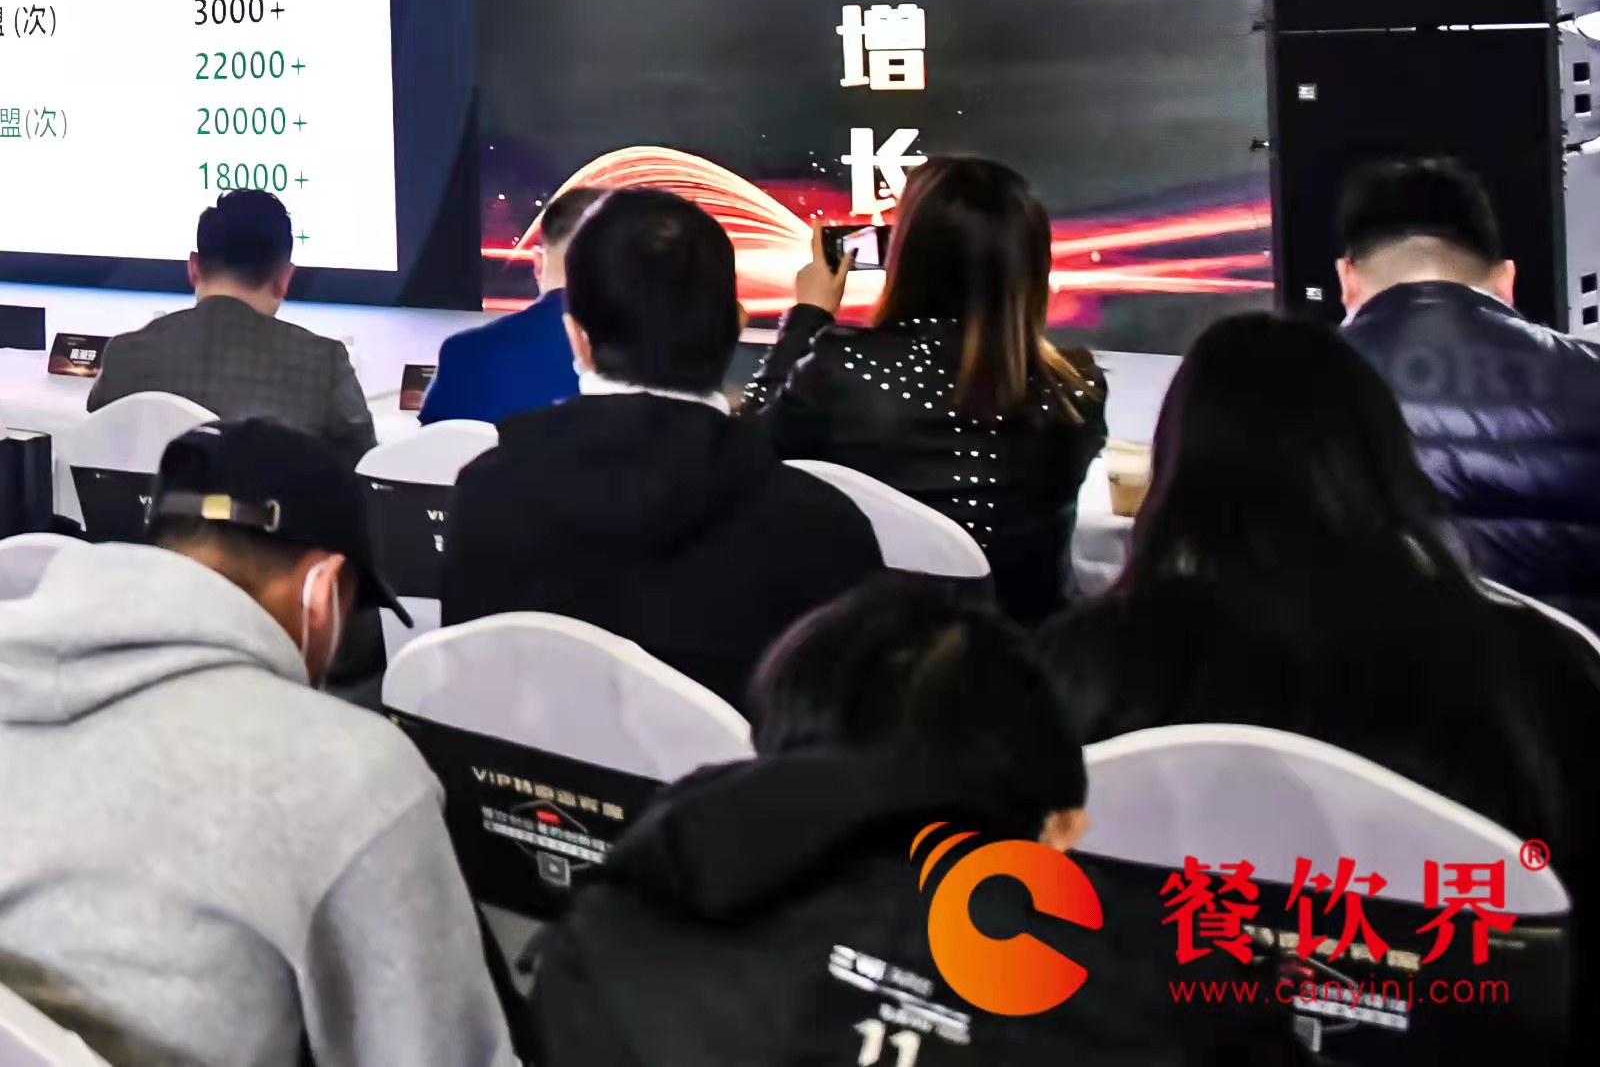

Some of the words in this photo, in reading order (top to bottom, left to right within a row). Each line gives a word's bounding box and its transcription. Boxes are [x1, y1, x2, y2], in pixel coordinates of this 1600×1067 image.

[195, 50, 306, 80] 22000+
[197, 107, 308, 135] 20000+
[198, 162, 309, 191] 18000+
